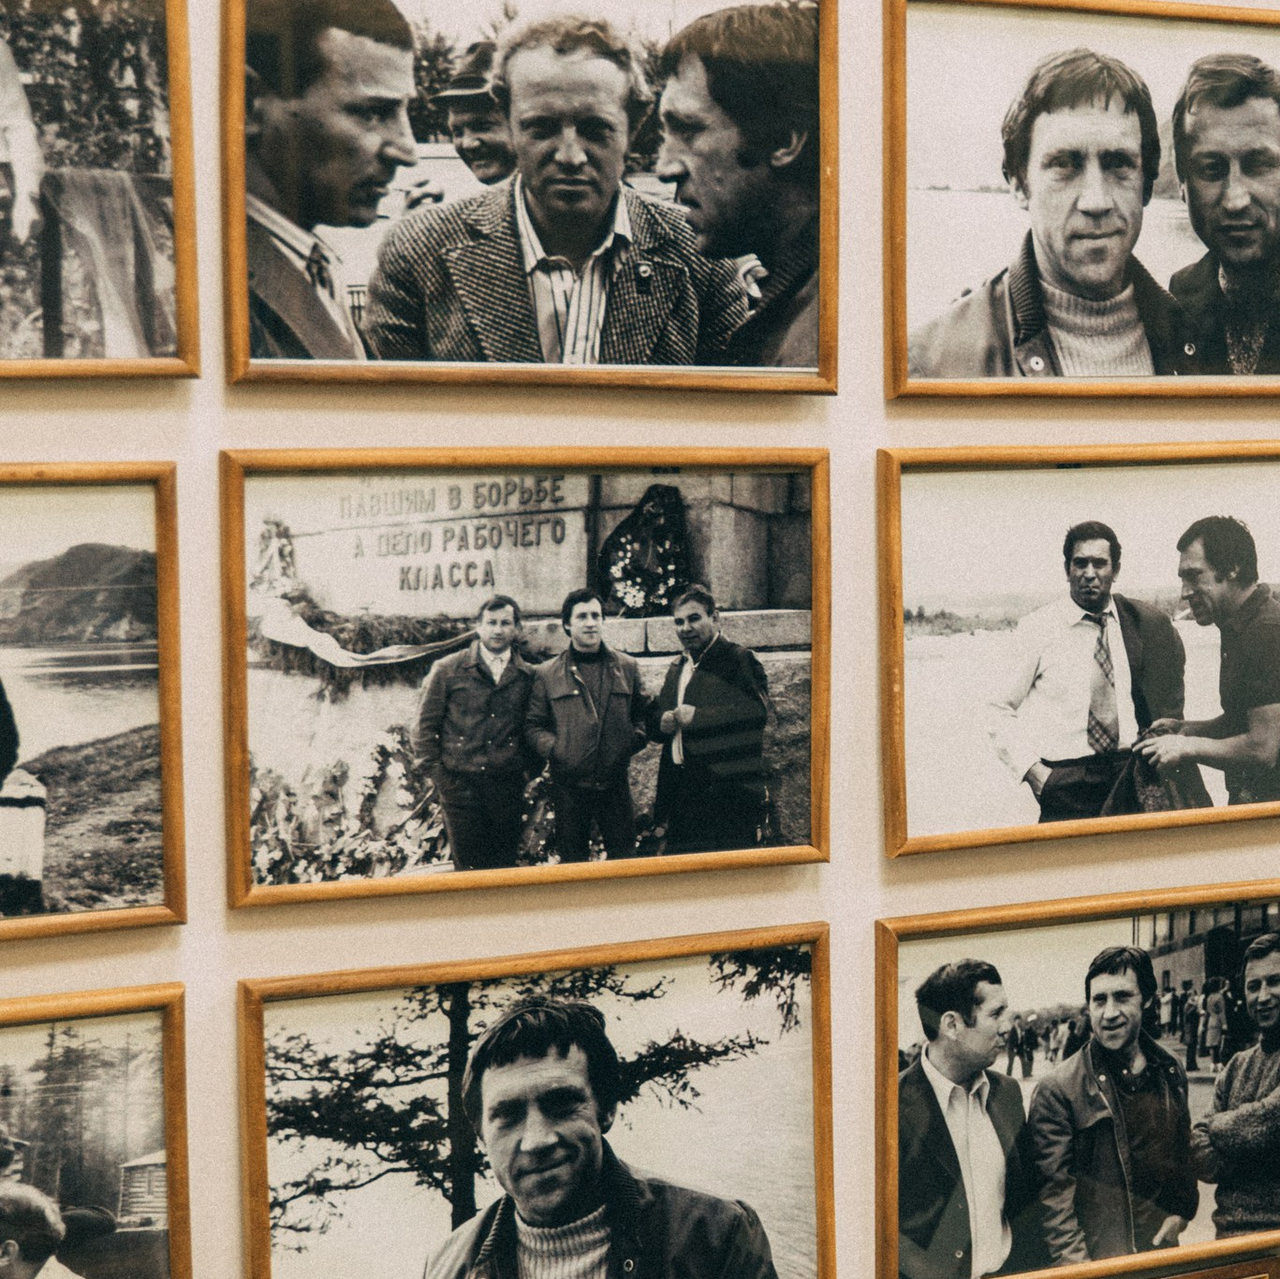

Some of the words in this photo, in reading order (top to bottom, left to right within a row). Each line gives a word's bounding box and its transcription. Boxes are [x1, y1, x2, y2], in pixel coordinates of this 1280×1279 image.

[448, 485, 461, 510] В
[473, 475, 565, 509] БОРЬБЕ
[377, 530, 432, 557] ДЕЛО
[442, 518, 566, 551] РАБОЧЕГО
[399, 560, 495, 592] КЛАССА
